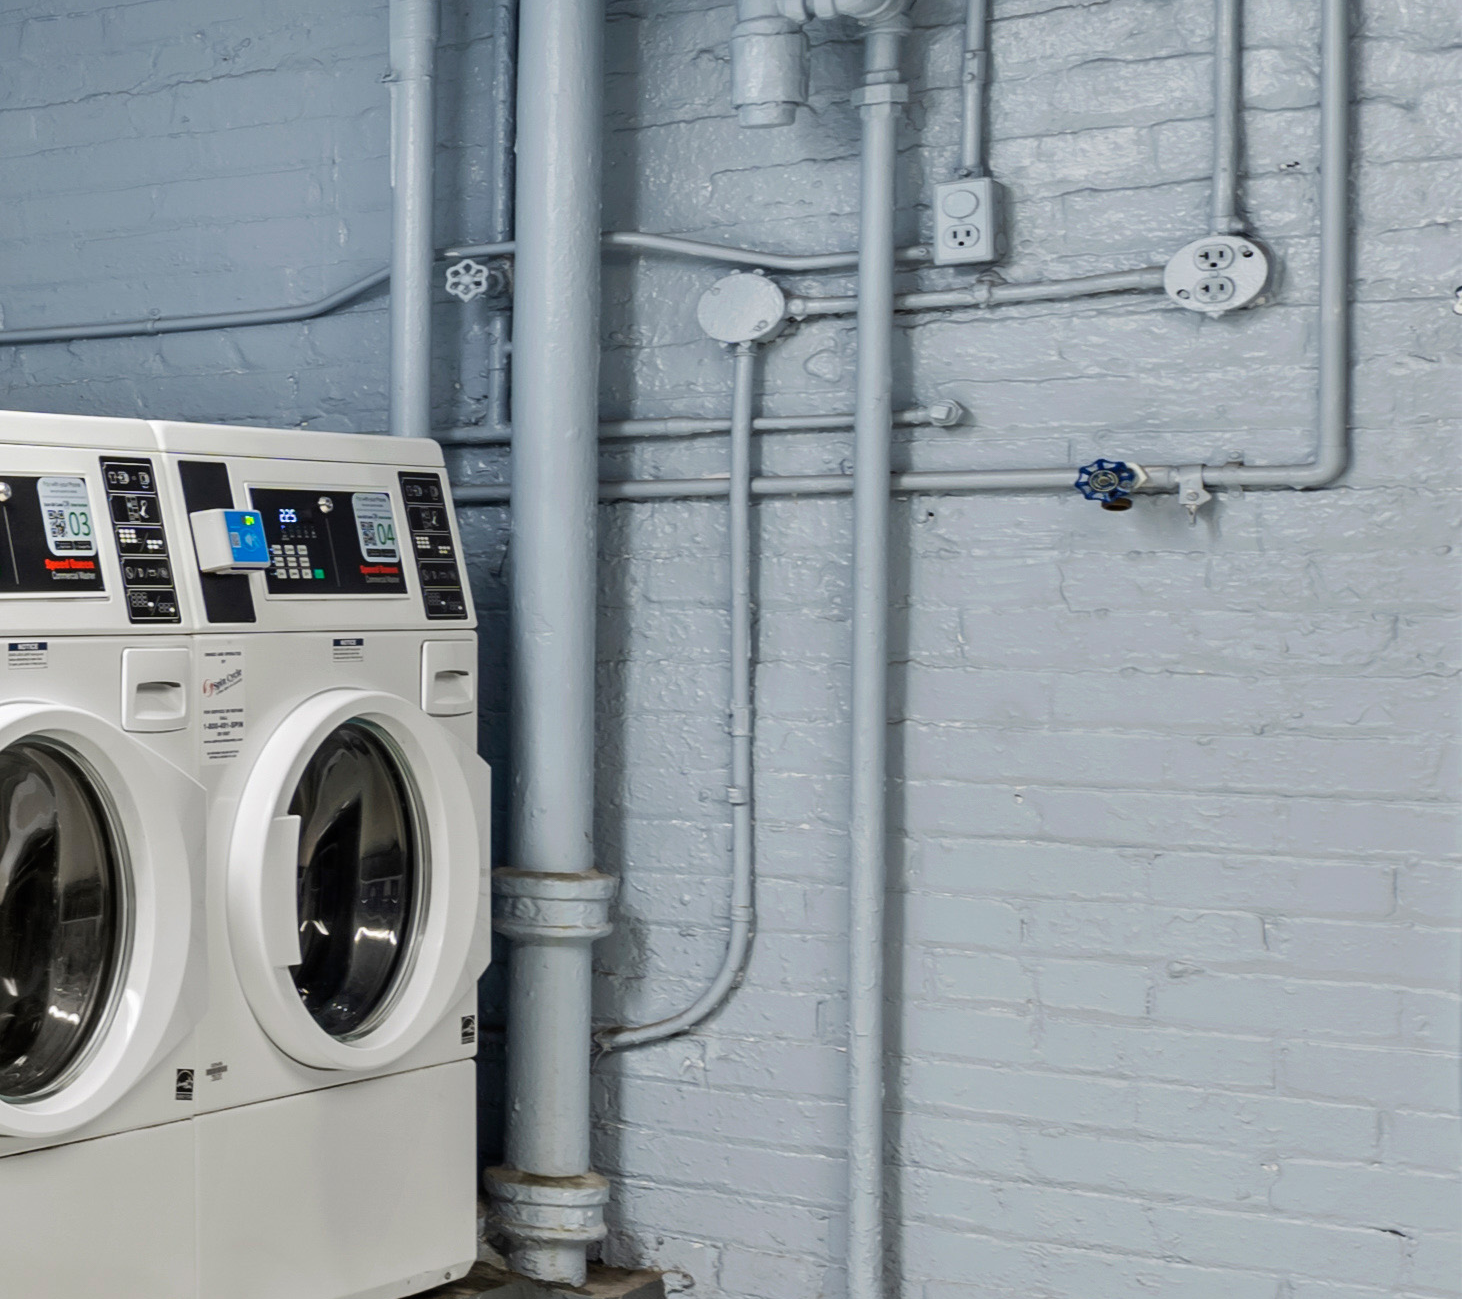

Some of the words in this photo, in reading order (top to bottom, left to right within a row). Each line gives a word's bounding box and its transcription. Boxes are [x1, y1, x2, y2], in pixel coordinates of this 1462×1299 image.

[69, 512, 91, 536] 03
[279, 509, 297, 523] 225
[377, 523, 395, 545] 04
